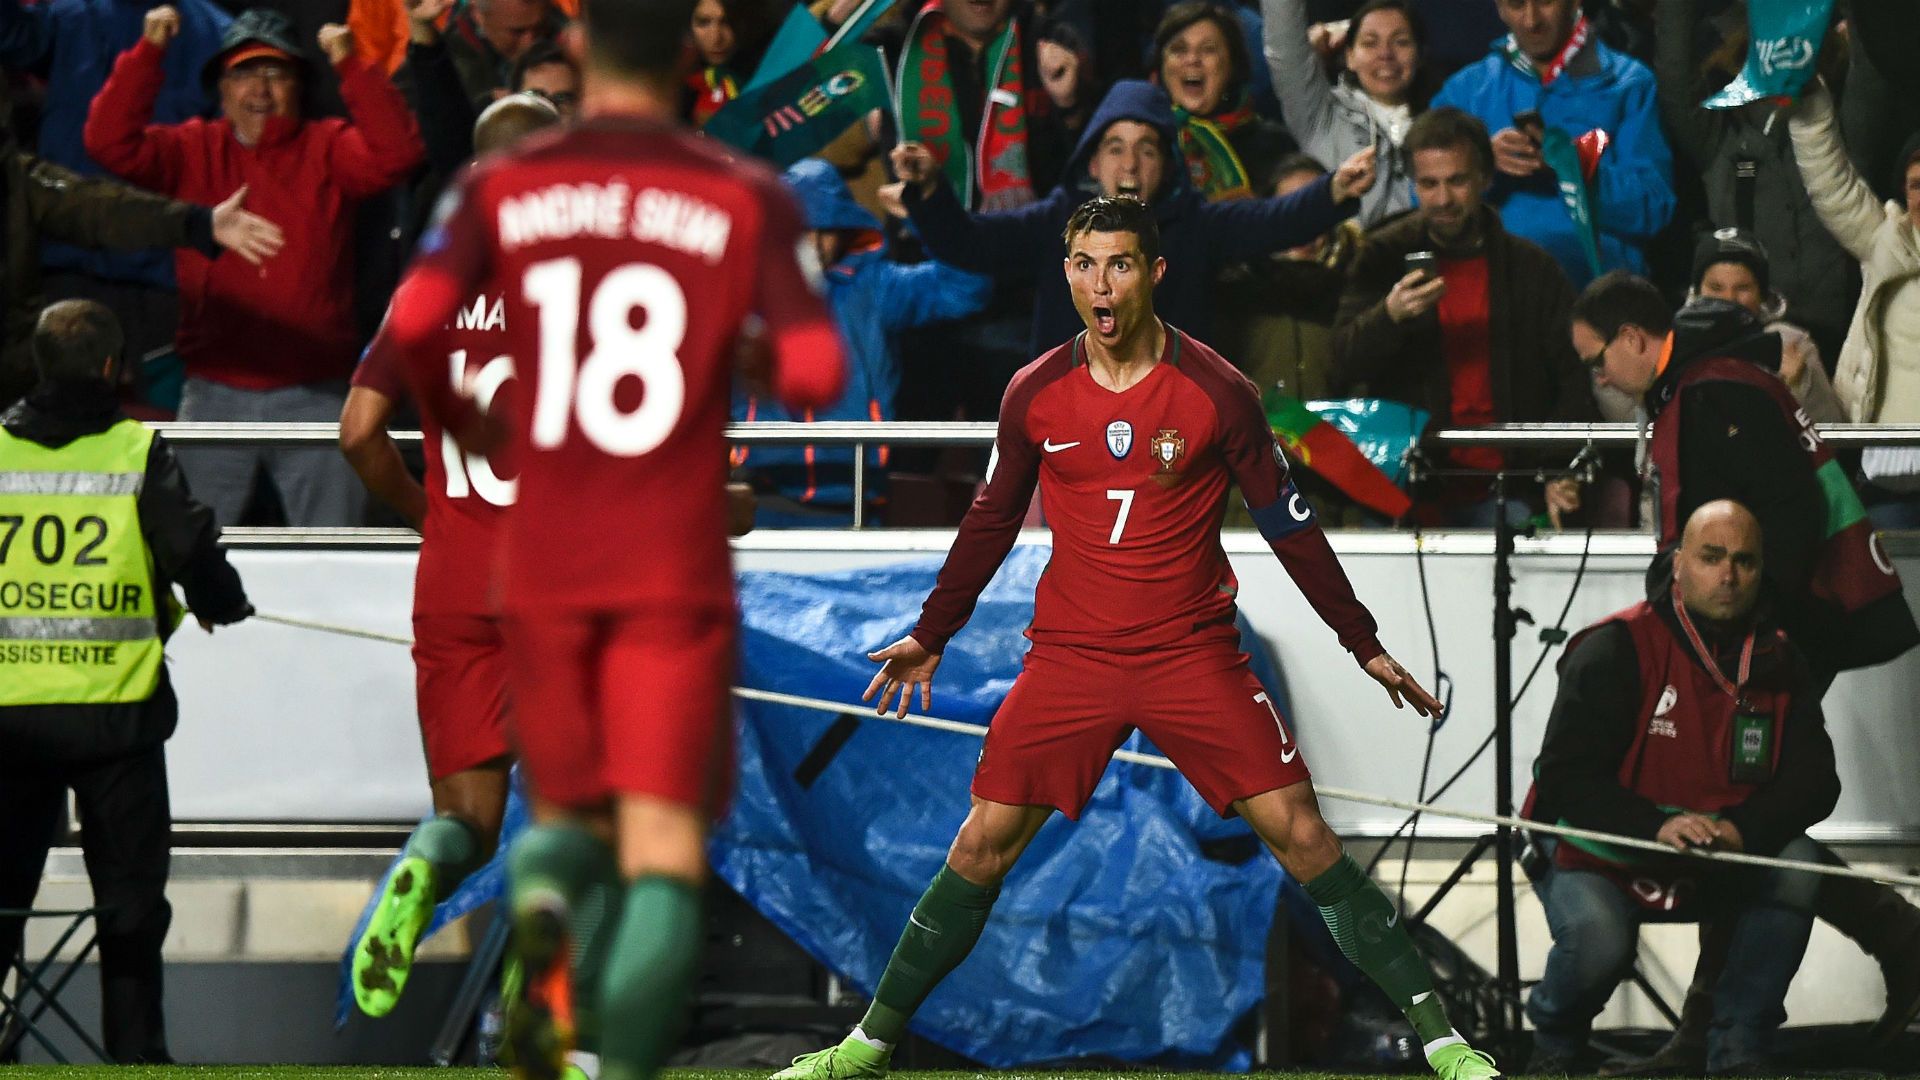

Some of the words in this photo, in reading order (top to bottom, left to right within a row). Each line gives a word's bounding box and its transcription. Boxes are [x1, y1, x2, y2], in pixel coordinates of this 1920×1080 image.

[521, 256, 688, 457] 18
[1106, 489, 1136, 545] 7
[1288, 492, 1311, 522] C
[0, 514, 109, 567] 702
[0, 580, 143, 612] OSEGUR
[1253, 691, 1288, 745] 7
